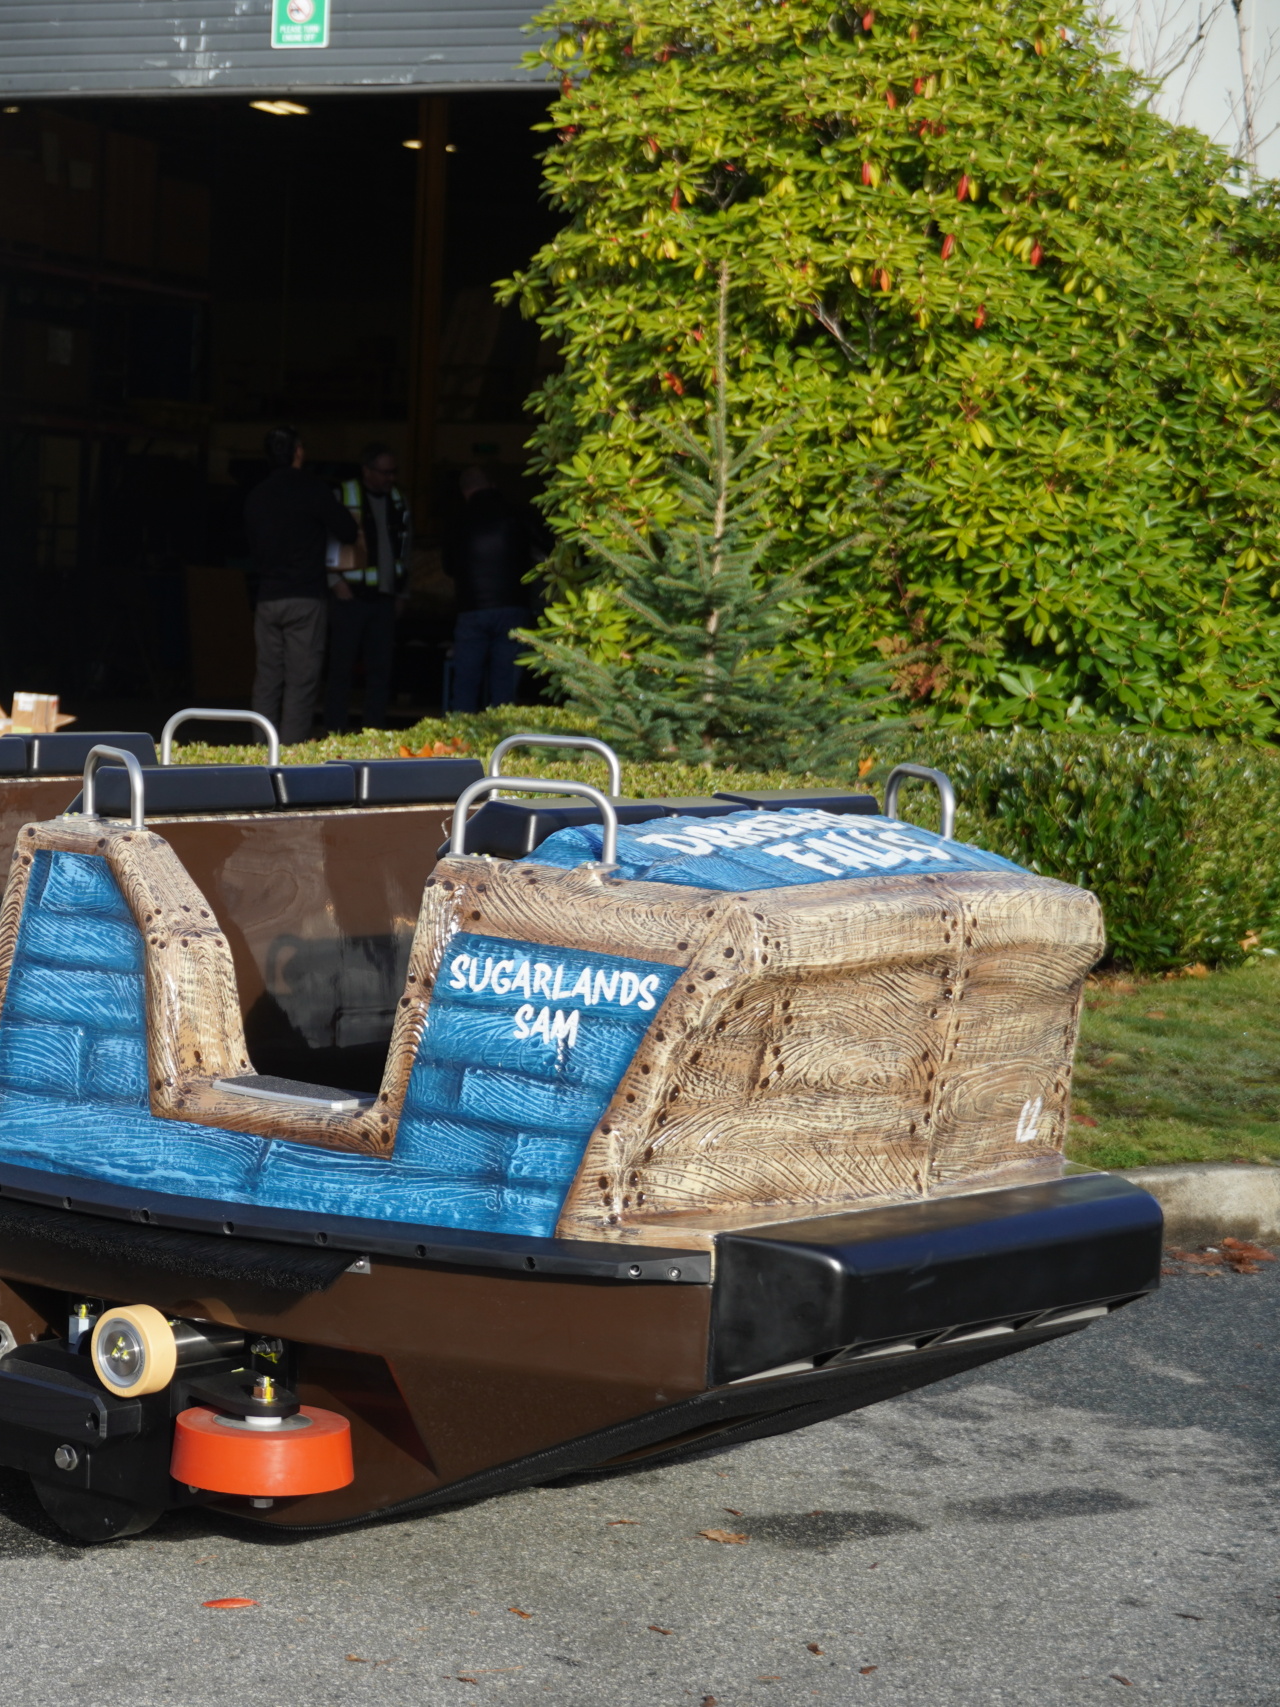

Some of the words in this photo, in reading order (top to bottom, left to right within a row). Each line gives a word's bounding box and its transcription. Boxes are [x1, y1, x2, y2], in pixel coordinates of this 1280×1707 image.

[762, 829, 952, 877] FALLS
[449, 953, 661, 1011] SUGARLANDS
[513, 1003, 580, 1049] SAM
